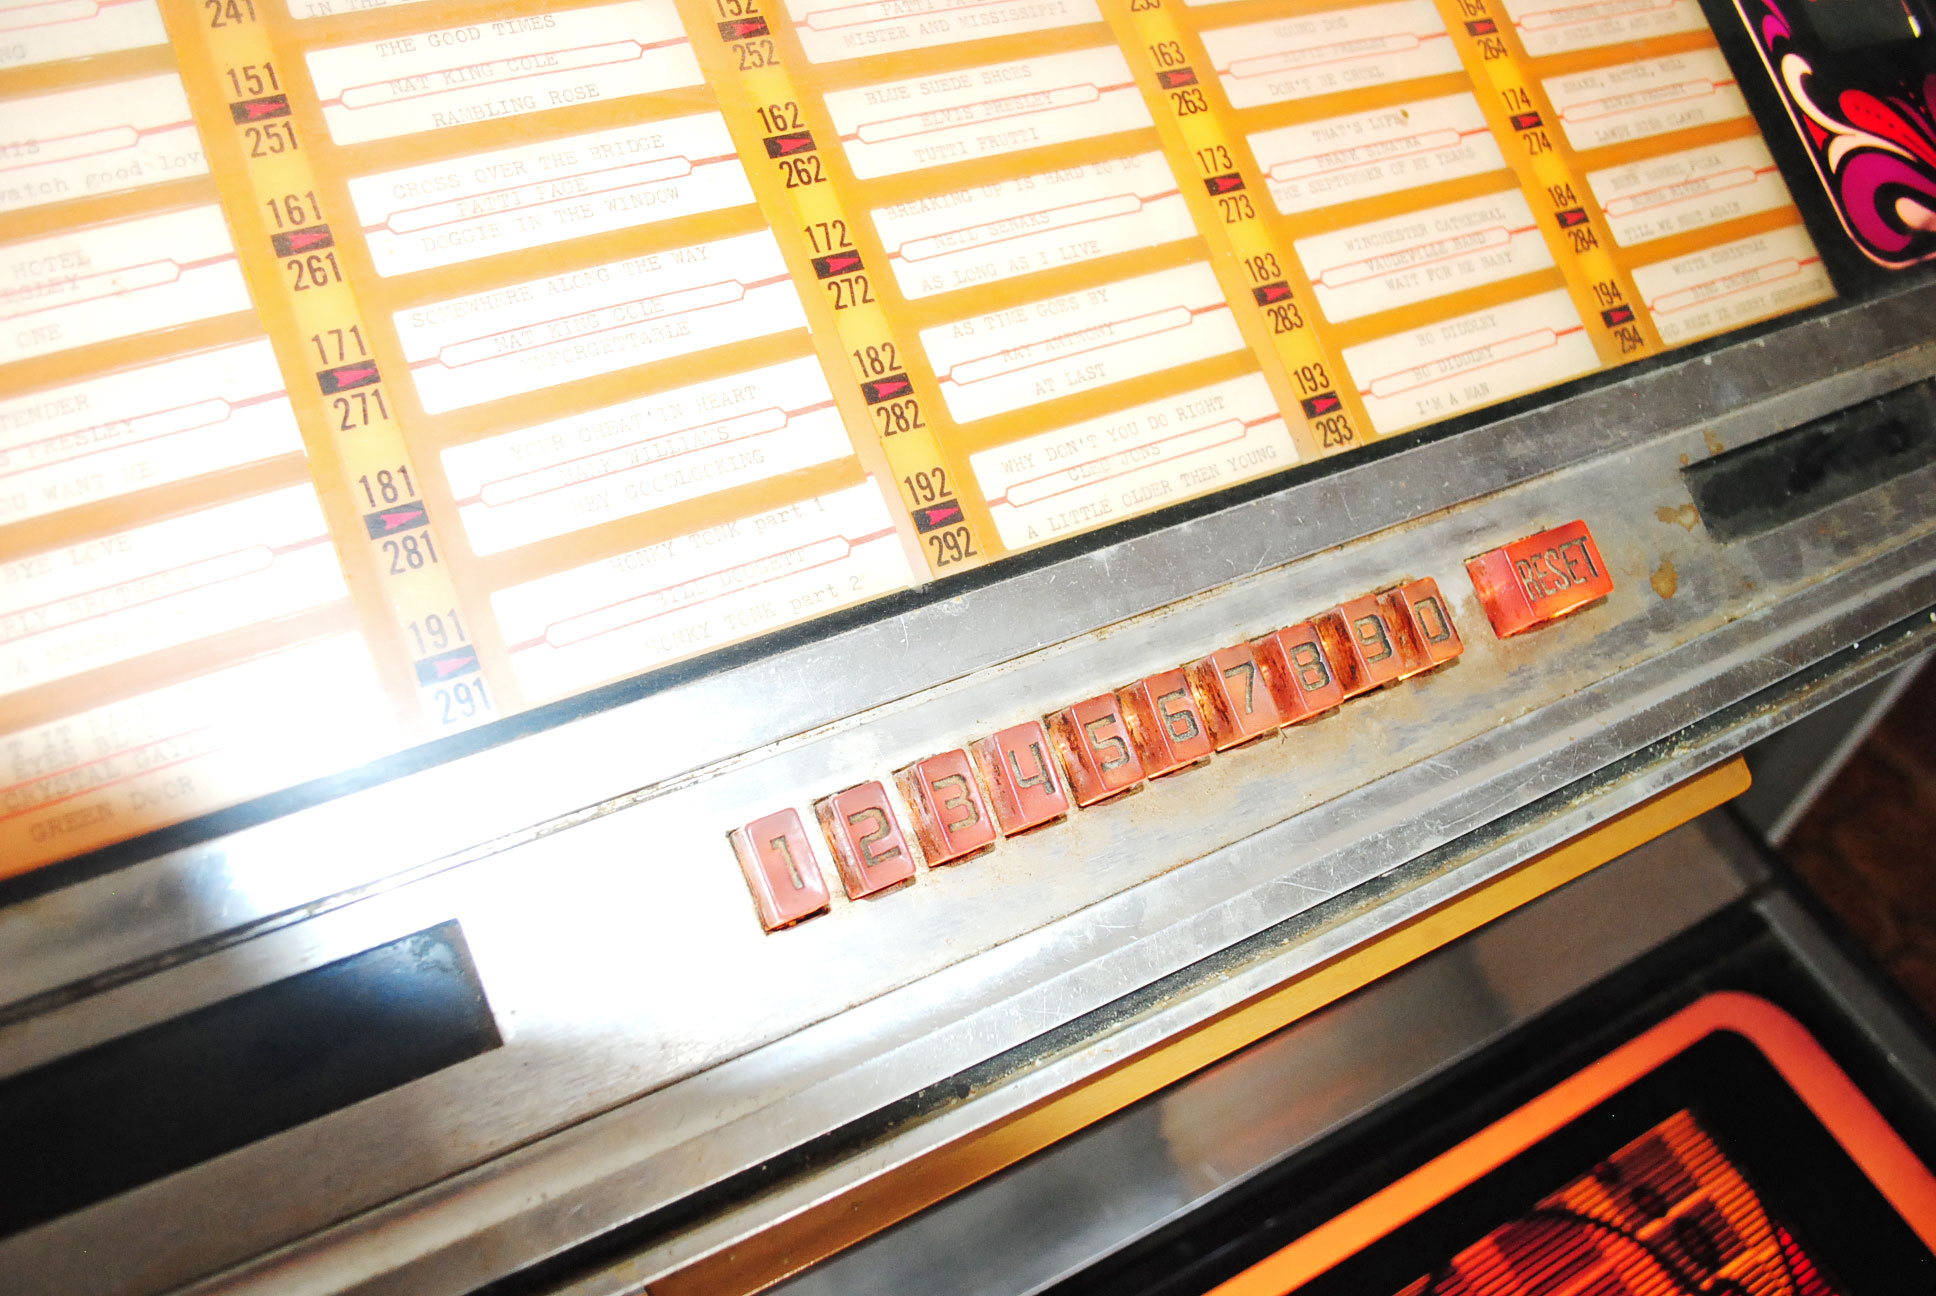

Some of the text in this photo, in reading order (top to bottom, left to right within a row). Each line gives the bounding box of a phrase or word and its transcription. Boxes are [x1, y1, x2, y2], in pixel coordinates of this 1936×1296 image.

[205, 0, 256, 28] 241
[842, 2, 1068, 48] MISTER AND MISSISSIPPI
[375, 15, 556, 58] THE GOOD TIMES
[732, 39, 780, 71] 252
[1150, 41, 1185, 68] 163
[1478, 37, 1508, 60] 264
[227, 62, 279, 97] 151
[389, 52, 558, 95] NAT KING COLE
[864, 65, 1032, 106] BLUE SUEDE SHOES
[432, 84, 600, 127] RAMBLING ROSE
[921, 91, 1053, 127] ELVIS PRESLEY
[1171, 88, 1208, 116] 263
[1502, 86, 1531, 111] 174
[757, 102, 804, 133] 162
[1312, 121, 1363, 143] THAT'S
[245, 121, 298, 158] 251
[914, 128, 1039, 163] TUTTI FRUTTI
[1523, 131, 1552, 155] 274
[86, 161, 143, 189] good
[392, 134, 664, 199] CROSS OVER THE BRIDGE
[778, 155, 827, 189] 262
[1196, 145, 1233, 174] 173
[267, 191, 322, 228] 161
[456, 178, 589, 216] PATTI PAGE
[886, 190, 973, 220] BREAKING
[983, 182, 1003, 199] UP
[1016, 175, 1035, 191] IS
[1045, 167, 1084, 186] HARD
[1096, 162, 1117, 176] TO
[1219, 194, 1256, 223] 273
[1548, 182, 1578, 208] 184
[421, 184, 679, 252] DOGGIE IN THE WINDOW
[804, 220, 852, 253] 172
[934, 229, 978, 248] NEIL
[1568, 227, 1599, 255] 284
[11, 249, 91, 279] HOTEL
[287, 252, 342, 291] 261
[921, 241, 1101, 293] AS LONG AS I LIVE
[1245, 252, 1282, 283] 183
[412, 246, 710, 328] SOMEWHERE ALONG THE WAY
[827, 275, 875, 310] 272
[1593, 279, 1622, 306] 194
[952, 289, 1109, 339] AS TIME GOES BY
[1267, 303, 1304, 335] 283
[311, 325, 366, 365] 171
[494, 329, 534, 352] NAT
[547, 314, 600, 338] KING
[1000, 322, 1116, 362] RAY ANTHONY
[1614, 326, 1644, 354] 294
[853, 342, 902, 378] 182
[1034, 364, 1107, 396] AT LAST
[1293, 362, 1330, 396] 193
[333, 388, 388, 431] 271
[696, 386, 757, 411] HEART
[876, 399, 926, 437] 282
[1001, 396, 1225, 474] WHY DON'T YOU DO RIGHT
[1316, 414, 1354, 448] 293
[625, 426, 729, 464] WILLIAMS
[358, 465, 415, 508] 181
[903, 467, 953, 507] 192
[1026, 445, 1276, 540] A LITTLE OLDER THEN YOUNG
[753, 504, 803, 535] part
[813, 496, 826, 512] 1
[382, 530, 438, 575] 281
[929, 526, 977, 567] 292
[1516, 536, 1599, 601] RESET
[789, 585, 839, 615] part
[849, 575, 864, 592] 2
[409, 608, 466, 655] 191
[434, 677, 492, 725] 291
[770, 596, 1450, 889] 1 2 3 4 5 6 7 8 9 0
